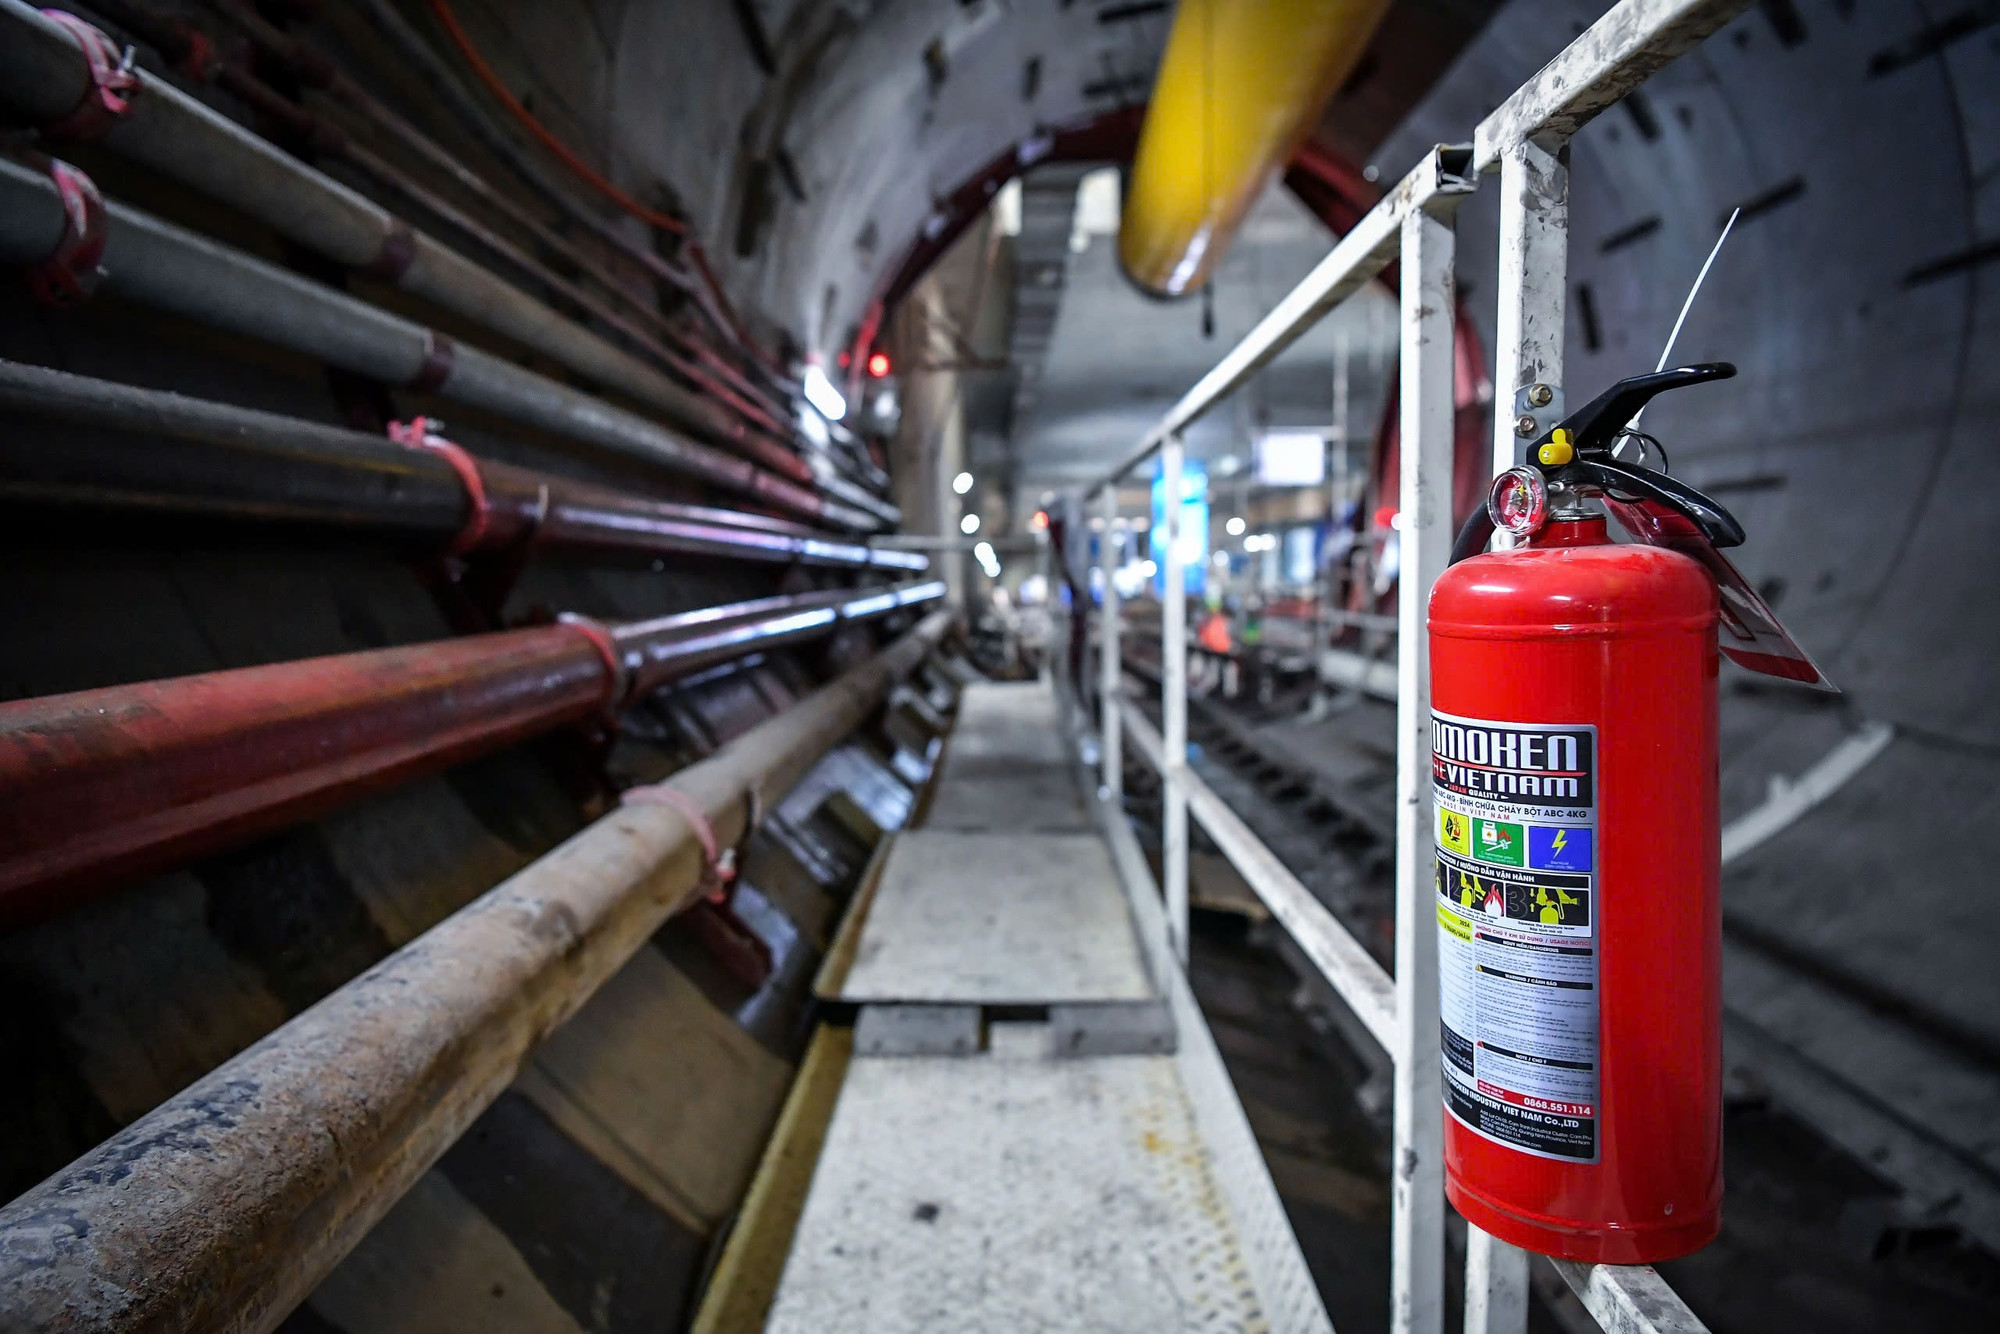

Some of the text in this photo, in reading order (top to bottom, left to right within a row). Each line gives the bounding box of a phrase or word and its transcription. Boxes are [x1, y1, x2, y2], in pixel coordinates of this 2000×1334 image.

[1431, 718, 1577, 771] OMOKEN
[1468, 789, 1499, 799] QUALITY
[1443, 801, 1457, 809] MADE
[1460, 796, 1474, 806] BÌNH
[1475, 800, 1496, 811] CHỮA
[1498, 805, 1521, 816] CHÁY
[1524, 807, 1542, 818] BỘT
[1543, 810, 1564, 818] ABC
[1566, 810, 1587, 818] 4KG
[1480, 867, 1495, 878] DẪN
[1496, 870, 1511, 880] VẬN
[1512, 872, 1535, 882] HÀNH
[1470, 1090, 1502, 1111] INDUSTRY
[1502, 1105, 1519, 1117] VIET
[1520, 1110, 1543, 1122] NAM
[1544, 1116, 1580, 1128] Co.,LTD
[1524, 1097, 1591, 1115] 0868.551.114
